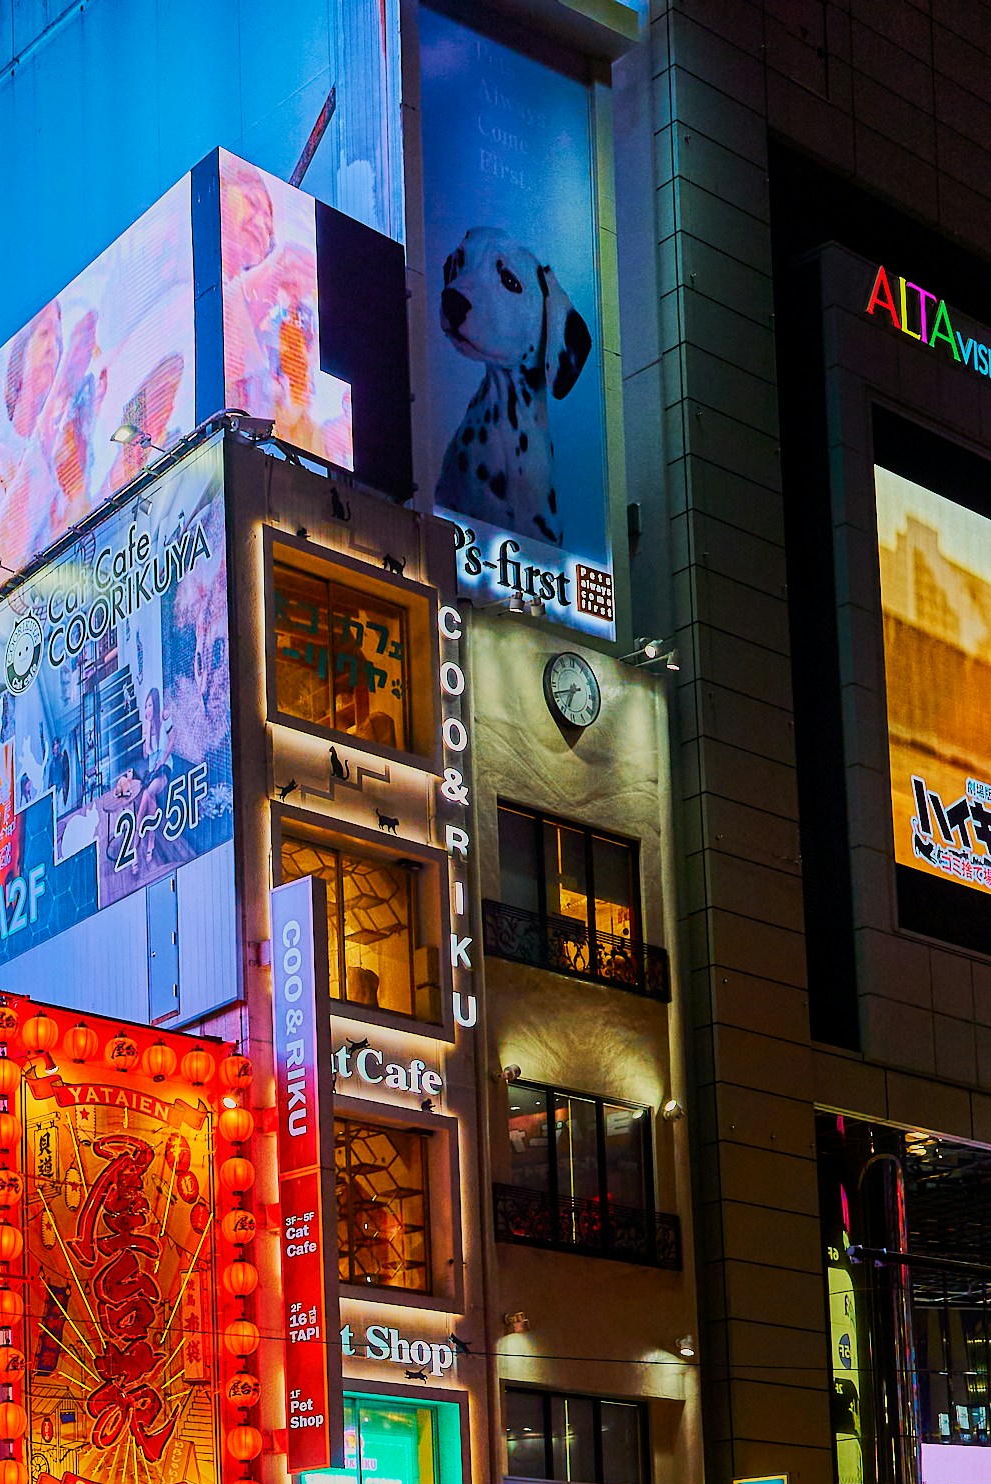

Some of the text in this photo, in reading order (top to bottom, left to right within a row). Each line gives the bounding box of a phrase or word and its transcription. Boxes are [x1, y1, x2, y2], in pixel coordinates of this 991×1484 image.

[866, 265, 961, 362] ALTA
[46, 524, 151, 626] Cat Cafe
[47, 519, 212, 669] COORIKUYA
[356, 1047, 444, 1096] Cafe
[67, 1086, 170, 1121] YATAIEN
[285, 1223, 310, 1240] Cat
[286, 1240, 318, 1258] Cafe
[290, 1302, 302, 1313] 2F
[289, 1313, 308, 1328] 16
[289, 1325, 320, 1343] TAPI
[365, 1324, 454, 1378] Shop
[289, 1389, 301, 1400] 1F
[290, 1398, 314, 1414] Pet
[289, 1413, 325, 1430] Shop
